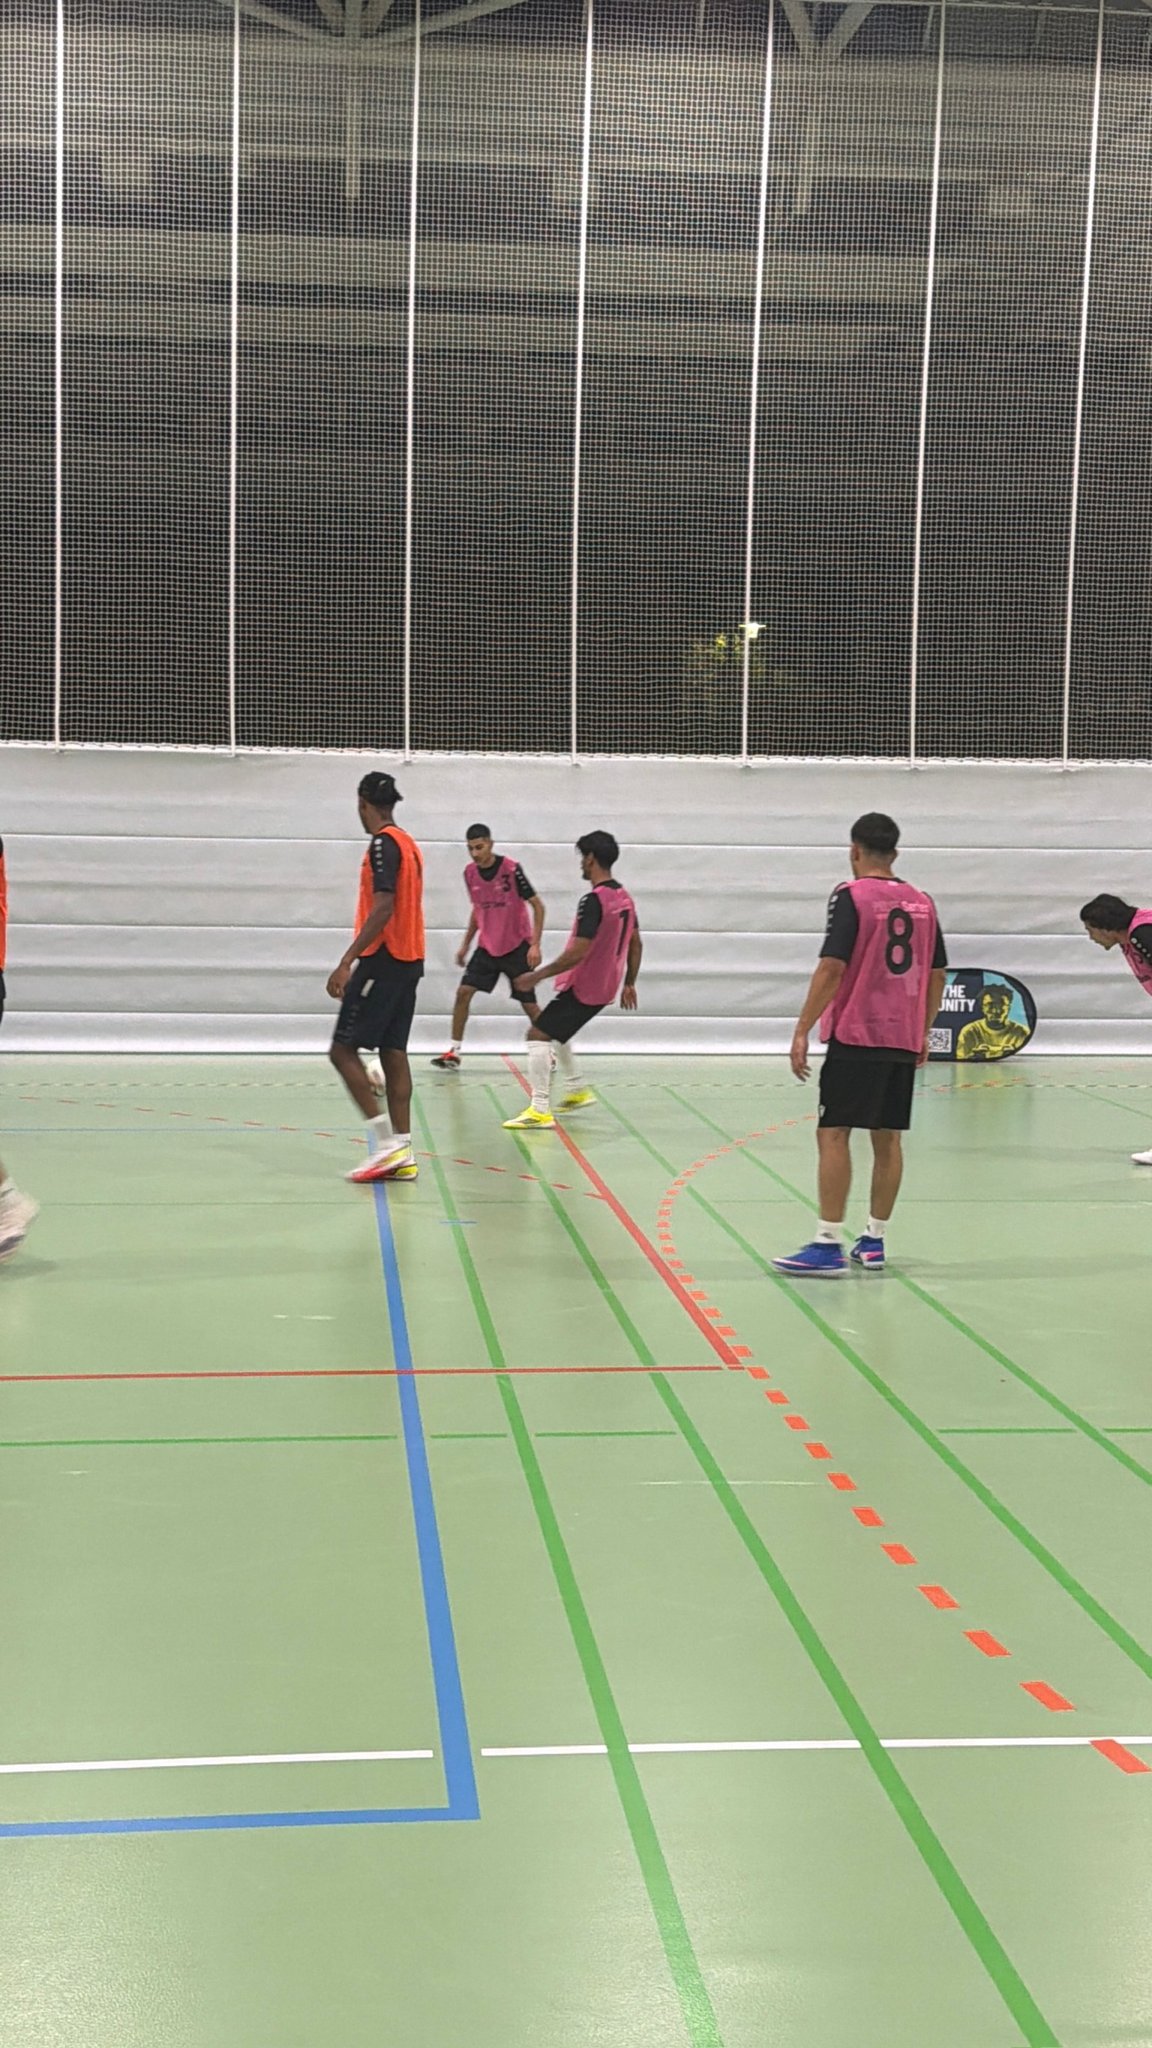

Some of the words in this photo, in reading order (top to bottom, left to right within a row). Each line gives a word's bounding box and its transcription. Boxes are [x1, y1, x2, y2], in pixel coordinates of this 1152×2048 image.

[502, 874, 511, 892] 3
[885, 907, 913, 975] 8
[942, 984, 966, 998] THE
